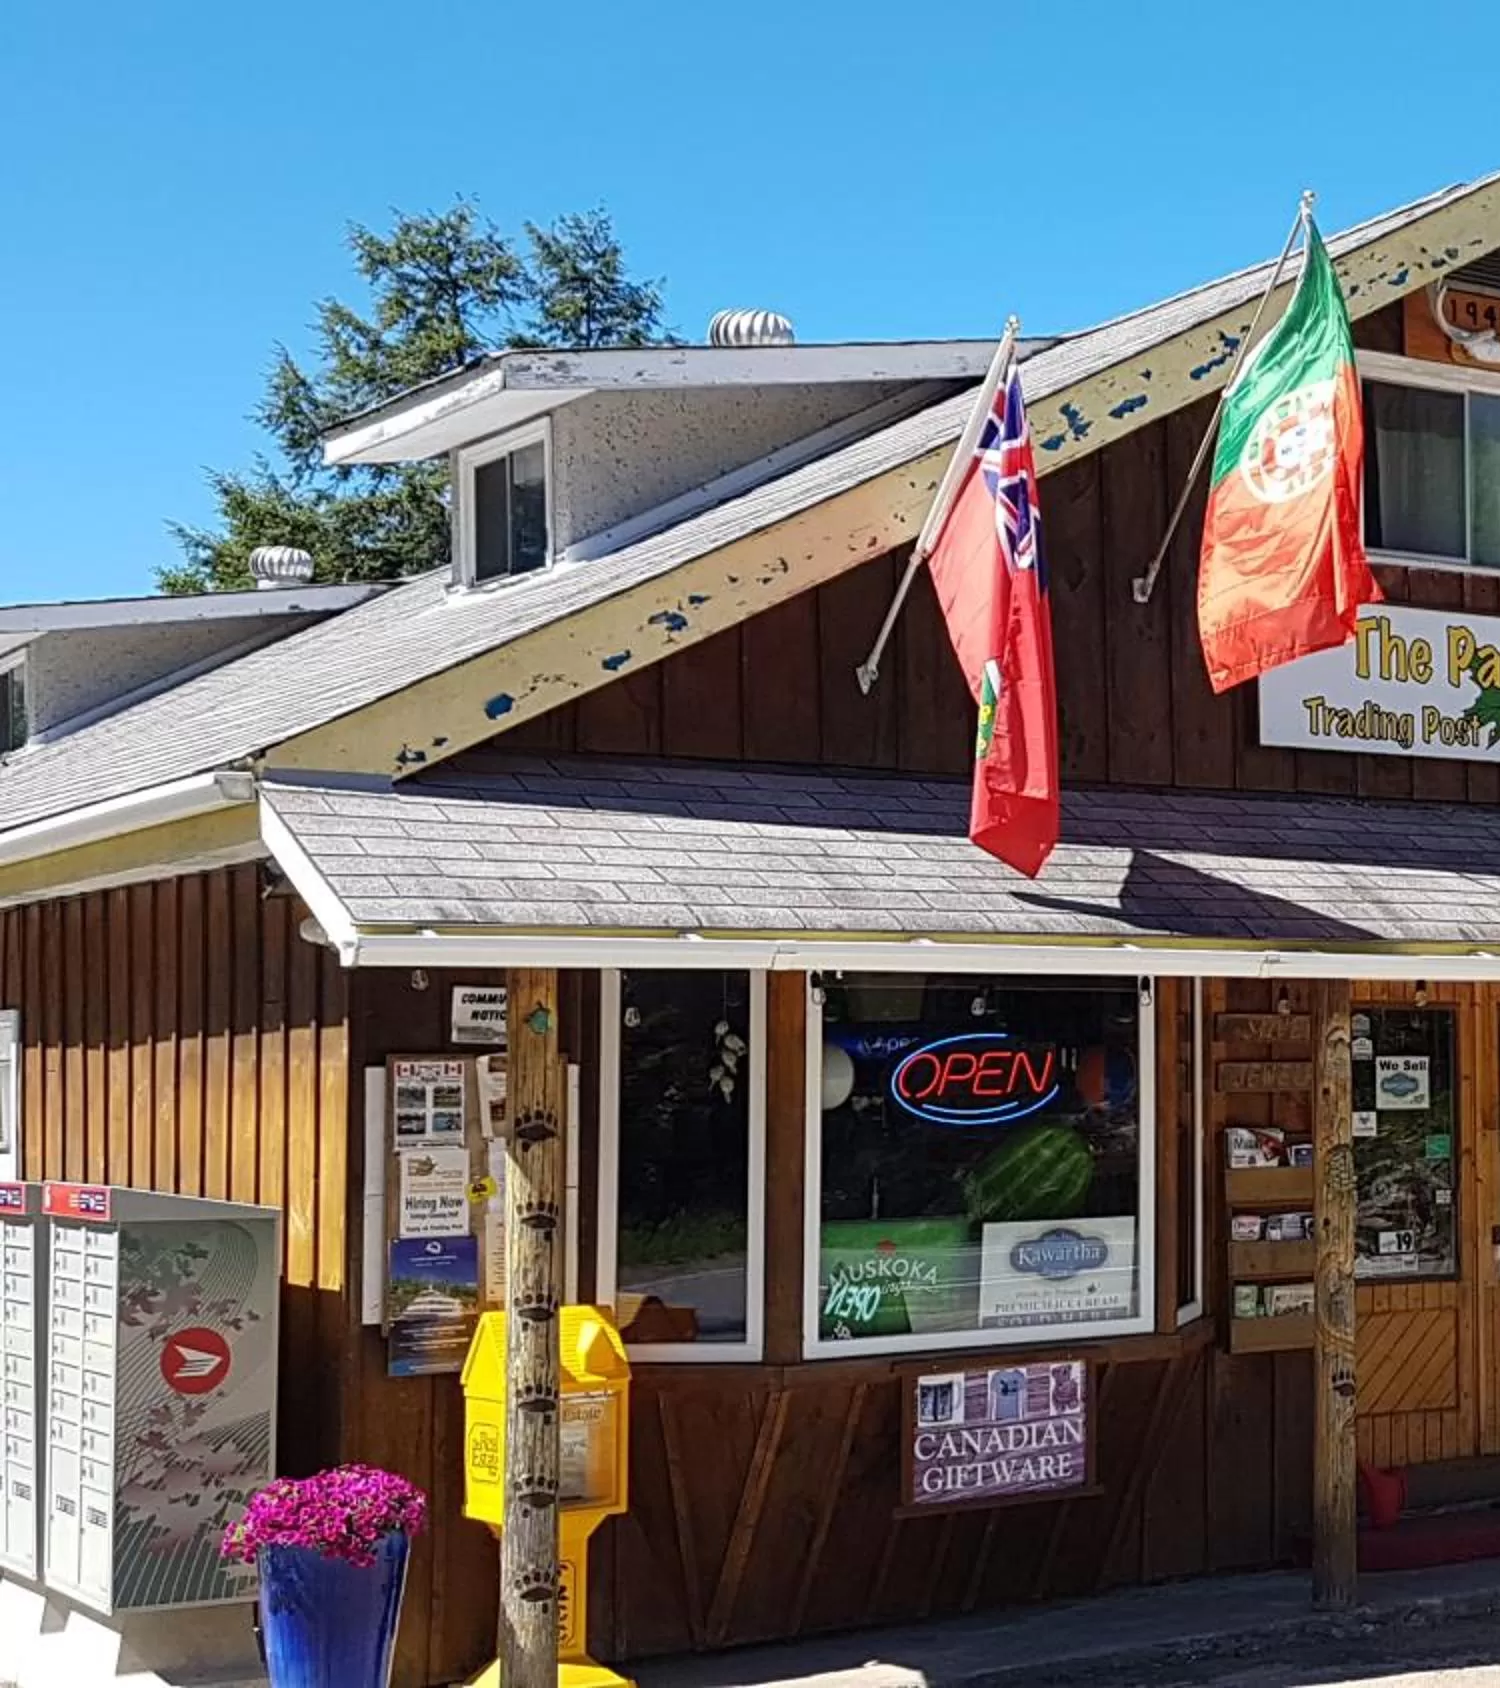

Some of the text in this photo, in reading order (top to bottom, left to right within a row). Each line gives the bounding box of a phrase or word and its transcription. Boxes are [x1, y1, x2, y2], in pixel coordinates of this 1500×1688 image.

[1355, 616, 1434, 684] The
[1303, 696, 1414, 749] Trading
[1422, 706, 1480, 747] Post
[461, 993, 508, 1005] COMMU
[470, 1010, 508, 1021] NOTIC
[899, 1051, 1055, 1098] OPEN
[1403, 1060, 1427, 1071] Sell
[1018, 1243, 1101, 1267] Kawartha
[1396, 1231, 1413, 1251] 19
[829, 1257, 937, 1286] MUSKOKA
[914, 1419, 1084, 1461] CANADIAN
[923, 1453, 1073, 1492] GIFTWARE
